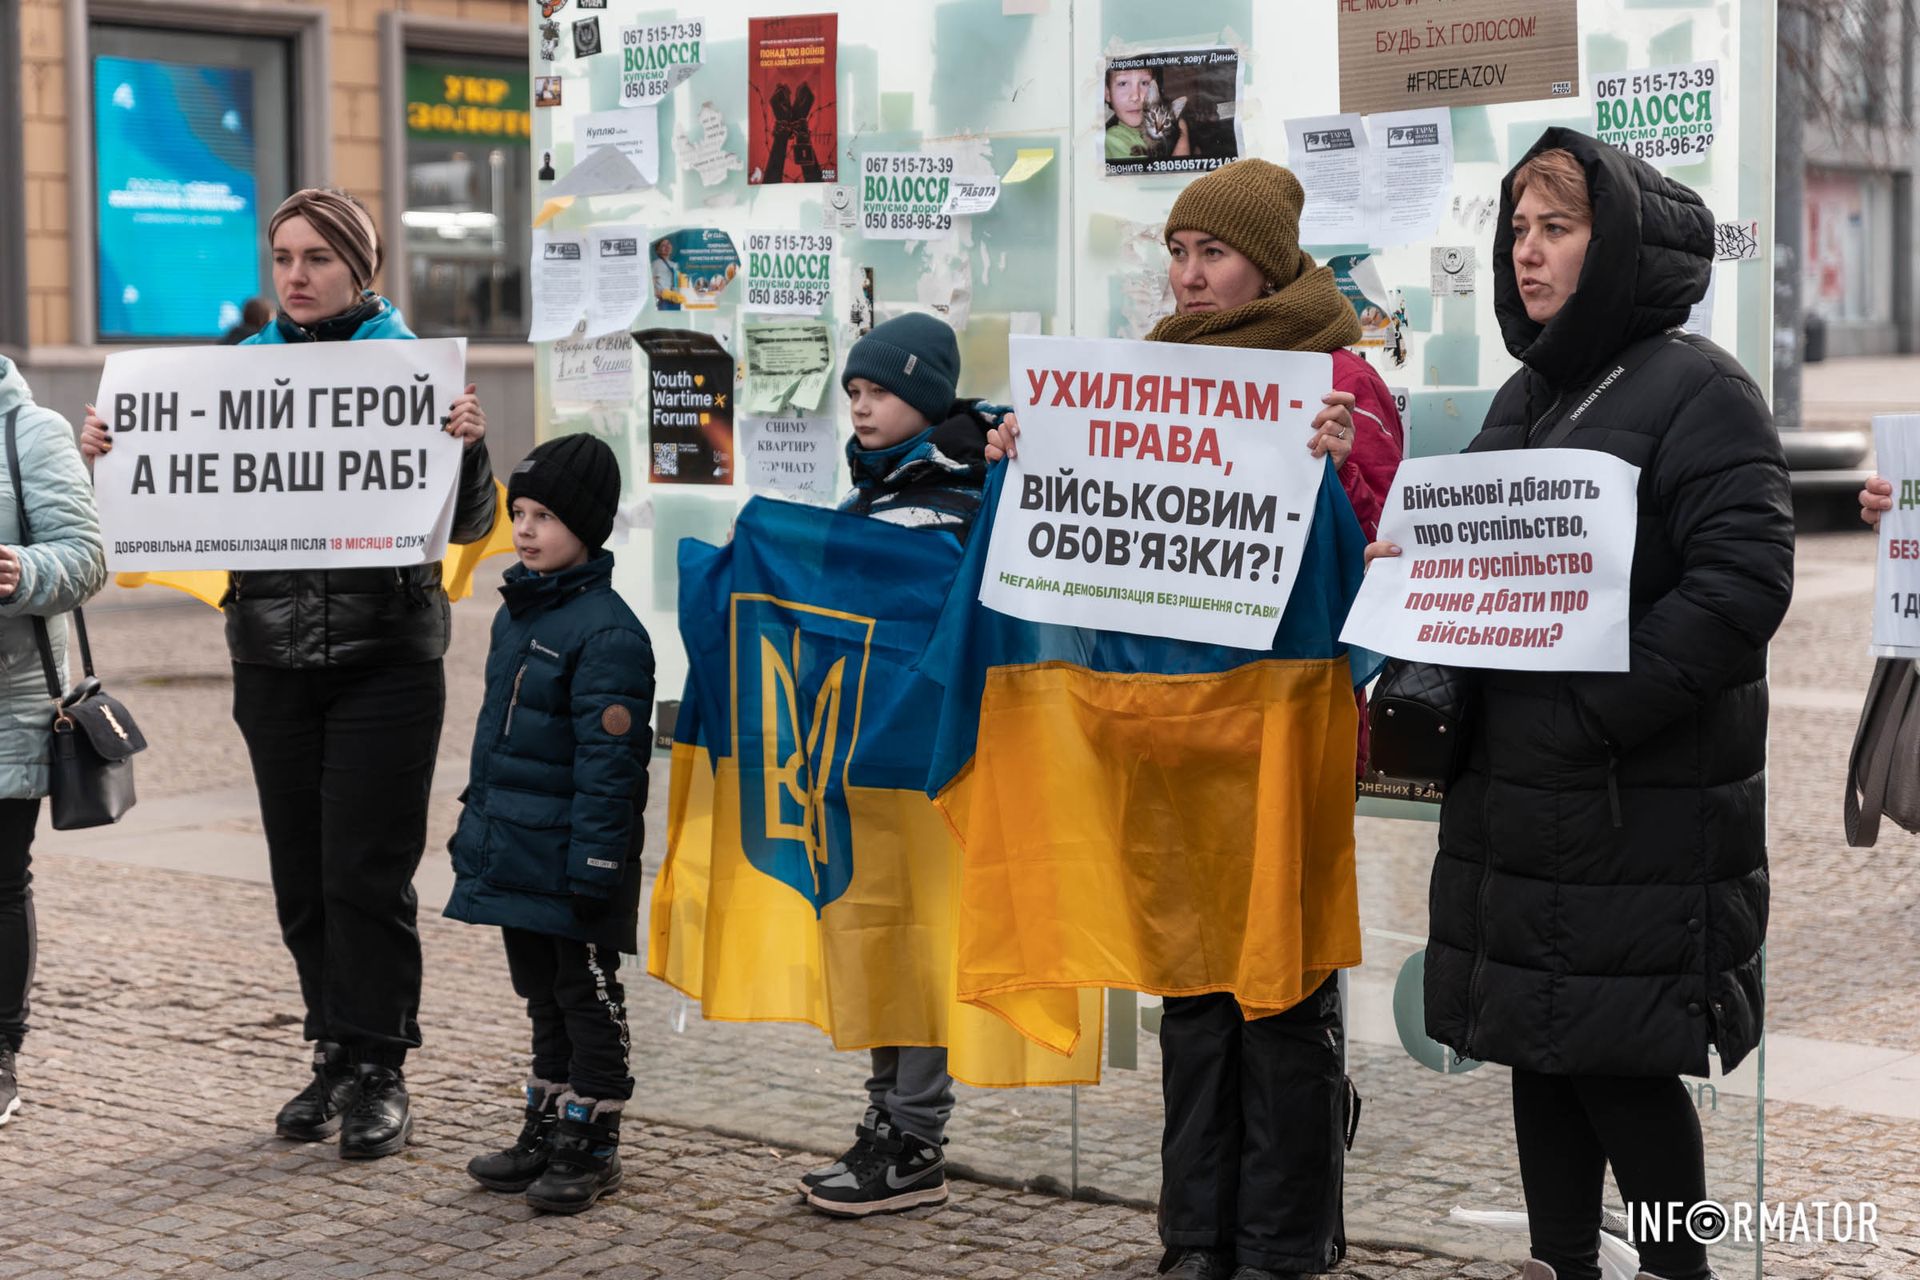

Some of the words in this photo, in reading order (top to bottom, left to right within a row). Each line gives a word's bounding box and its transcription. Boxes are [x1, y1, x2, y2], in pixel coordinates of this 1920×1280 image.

[624, 30, 643, 46] 067
[647, 22, 702, 42] 515-73-39
[1376, 28, 1421, 55] БУДЬ
[1426, 20, 1446, 48] ЇХ
[1451, 16, 1537, 44] ГОЛОСОМ!
[623, 41, 701, 72] ВОЛОССЯ
[1145, 57, 1181, 68] мальчик,
[1183, 55, 1206, 67] зовут
[624, 70, 664, 85] купуємо
[1407, 63, 1507, 93] #FREEAZOV
[1597, 78, 1627, 98] 067
[1632, 67, 1715, 95] 515-73-39
[444, 74, 510, 105] УКР
[625, 82, 645, 98] 050
[1596, 90, 1712, 132] ВОЛОССЯ
[587, 127, 616, 139] Куплю
[1661, 121, 1713, 140] дорого
[866, 158, 887, 173] 067
[892, 157, 953, 174] 515-73-39
[1104, 162, 1144, 174] Звоните
[864, 176, 950, 203] ВОЛОССЯ
[959, 186, 996, 198] РАБОТА
[864, 202, 908, 214] купуємо
[865, 213, 887, 229] 050
[891, 214, 952, 230] 858-96-29
[750, 235, 770, 250] 067
[774, 235, 832, 251] 515-73-39
[749, 252, 831, 279] ВОЛОССЯ
[748, 279, 792, 291] купуємо
[794, 280, 830, 292] дорого
[749, 290, 771, 304] 050
[652, 370, 692, 388] Youth
[114, 391, 179, 433] ВІН
[218, 377, 295, 430] МІЙ
[652, 390, 713, 407] Wartime
[1026, 368, 1280, 422] УХИЛЯНТАМ
[652, 409, 698, 426] Forum
[765, 421, 808, 433] СНИМУ
[757, 440, 818, 453] КВАРТИРУ
[1088, 420, 1235, 476] ПРАВА,
[130, 453, 156, 495] А
[168, 452, 220, 493] НЕ
[232, 450, 324, 493] ВАШ
[338, 448, 428, 491] РАБ!
[1020, 468, 1278, 534] ВІЙСЬКОВИМ
[1403, 477, 1504, 511] Військові
[1508, 476, 1601, 507] дбають
[1413, 521, 1454, 546] про
[1458, 514, 1588, 546] суспільство,
[114, 538, 193, 555] ДОБРОВІЛЬНА
[194, 537, 289, 555] ДЕМОБІЛІЗАЦІЯ
[290, 536, 328, 552] ПІСЛЯ
[329, 535, 343, 551] 18
[344, 535, 394, 551] МІСЯЦІВ
[1889, 539, 1920, 561] БЕЗ
[1410, 558, 1465, 580] коли
[1467, 551, 1593, 583] суспільство
[999, 571, 1062, 593] НЕГАЙНА
[1062, 581, 1155, 605] ДЕМОБІЛІЗАЦІЯ
[1156, 592, 1178, 607] БЕЗ
[1178, 594, 1233, 614] РІШЕННЯ
[1404, 590, 1475, 612] почне
[1476, 587, 1546, 615] дбати
[1549, 589, 1589, 614] про
[1890, 592, 1900, 613] 1
[1416, 620, 1564, 649] військових?
